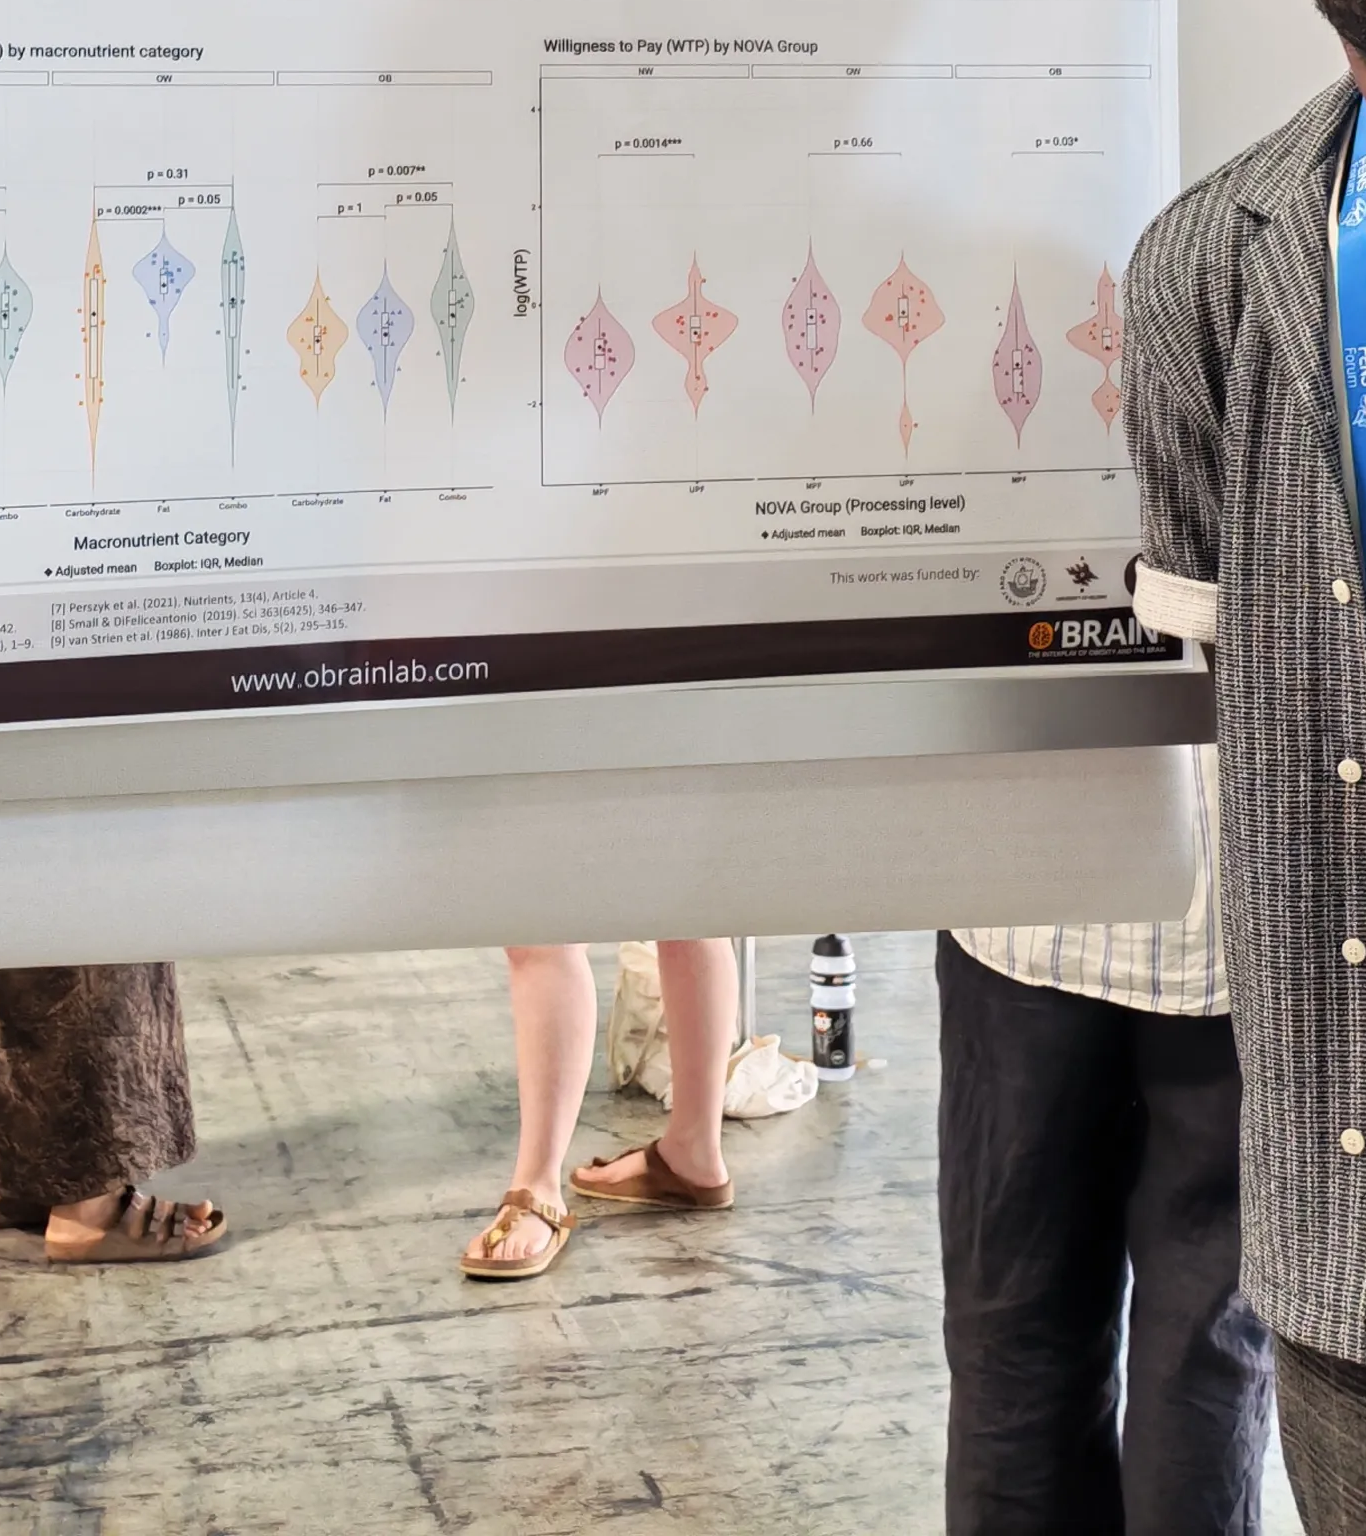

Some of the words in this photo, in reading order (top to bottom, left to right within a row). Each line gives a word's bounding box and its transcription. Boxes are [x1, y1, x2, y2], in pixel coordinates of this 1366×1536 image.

[543, 38, 616, 56] Willigness
[618, 40, 634, 53] to
[637, 39, 663, 56] Pay
[666, 38, 710, 56] (WTP)
[713, 38, 730, 56] by
[733, 39, 774, 53] NOVA
[777, 39, 819, 56] Group
[514, 249, 530, 316] log(WTP)
[1345, 348, 1358, 388] Forum
[755, 500, 797, 516] NOVA
[800, 500, 842, 516] Group
[845, 497, 927, 516] (Processing
[929, 494, 966, 512] level)
[74, 532, 180, 551] Macronutrient
[183, 530, 251, 548] Category
[829, 571, 855, 584] This
[857, 570, 888, 583] work
[889, 571, 914, 582] was
[916, 567, 960, 581] funded
[962, 567, 980, 582] by:
[231, 659, 488, 692] www.obrainlab.com
